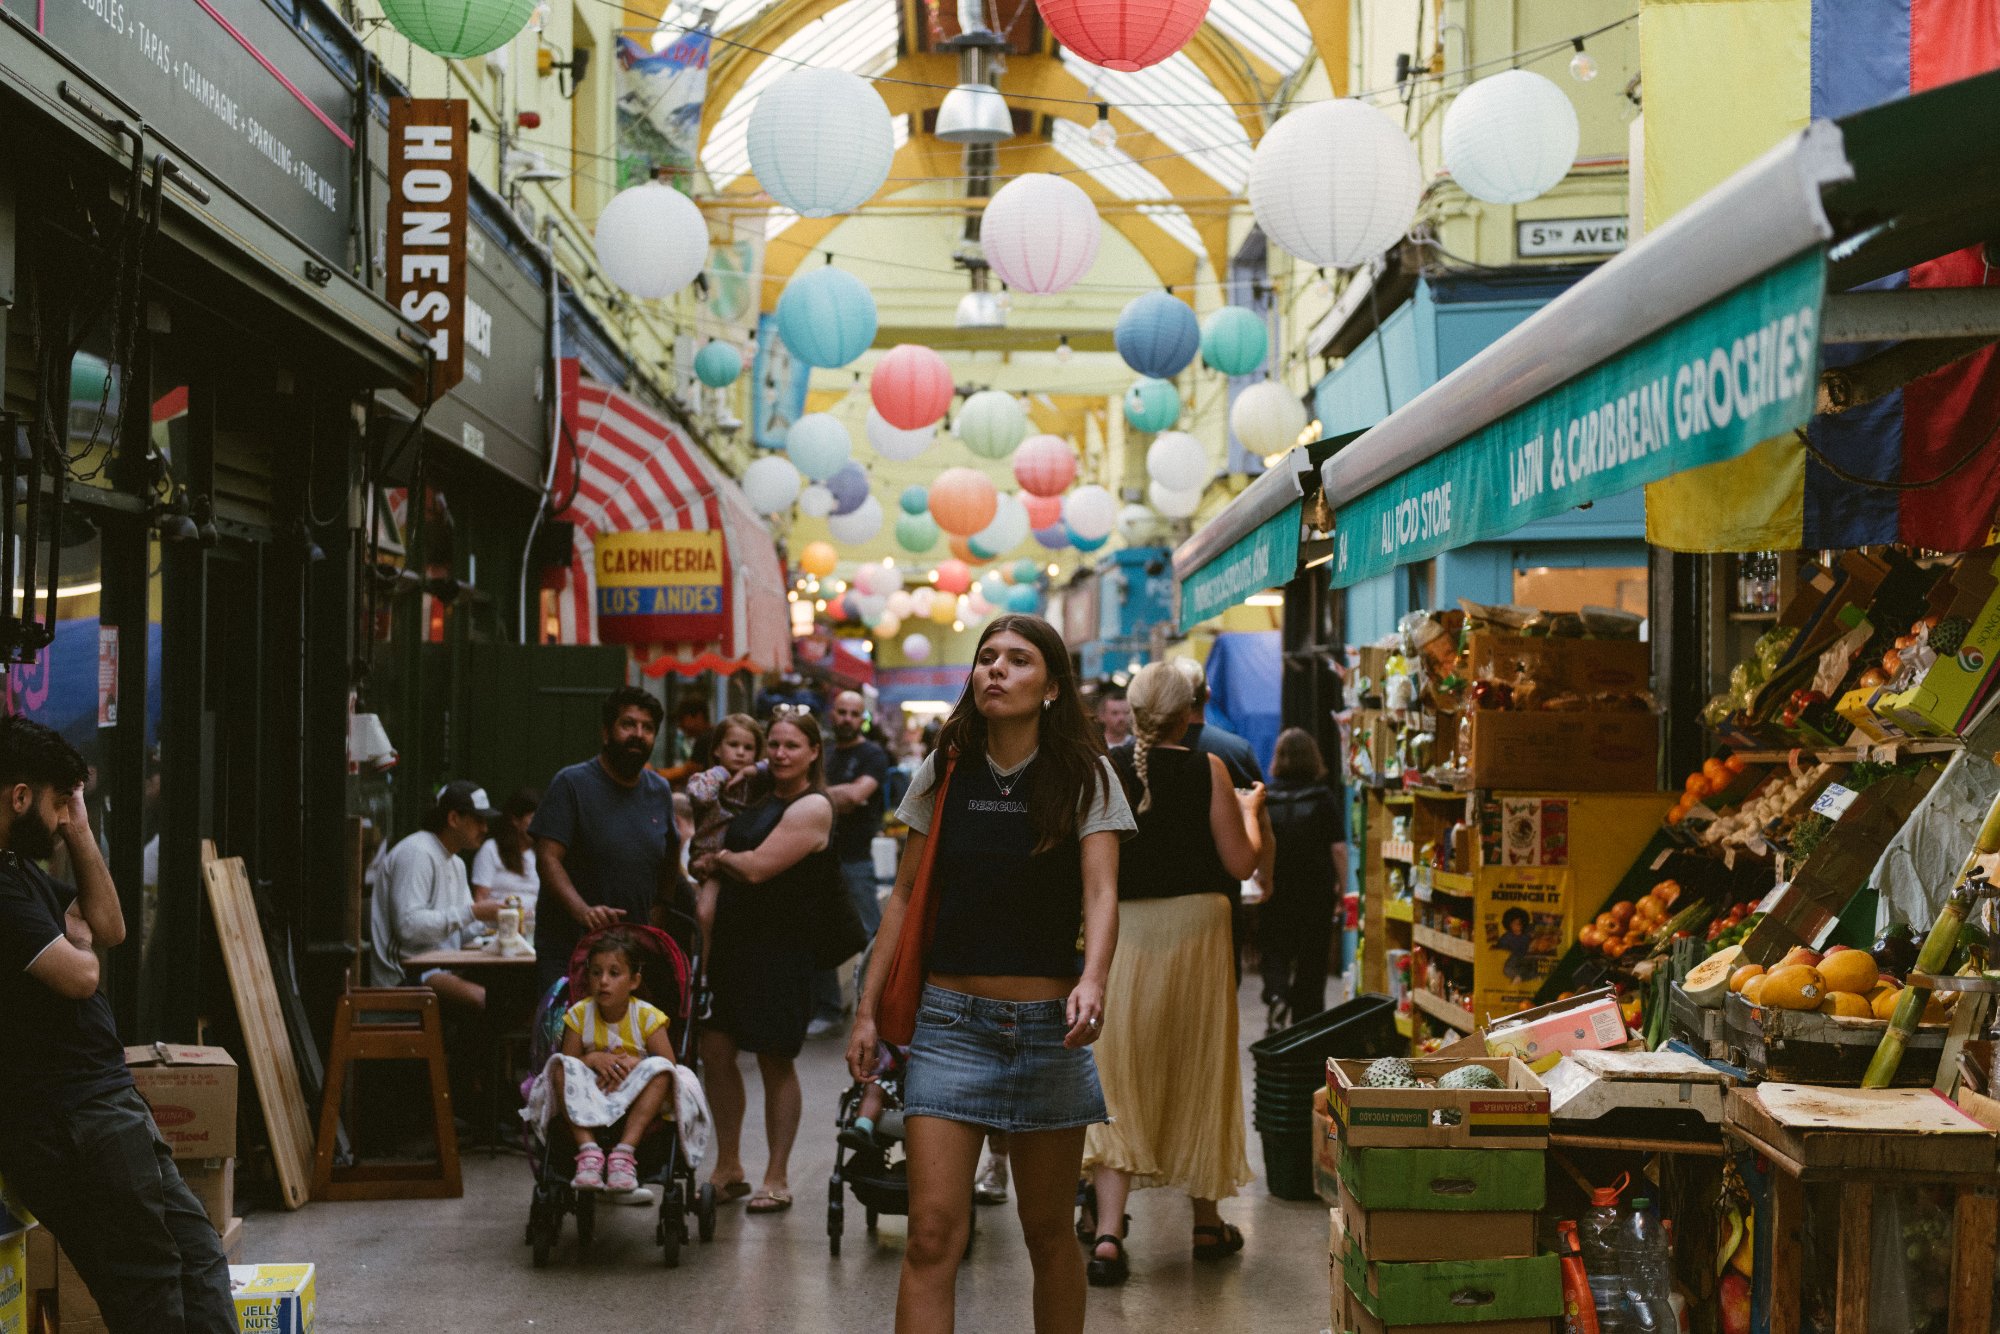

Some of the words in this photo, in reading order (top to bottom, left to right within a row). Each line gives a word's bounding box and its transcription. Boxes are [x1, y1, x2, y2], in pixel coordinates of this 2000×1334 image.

[138, 22, 170, 74] TAPAS
[182, 62, 239, 131] CHAMPAGNE
[248, 116, 292, 176] SPARKLING
[299, 160, 317, 197] FINE
[318, 178, 337, 213] WINE
[401, 125, 453, 360] HONEST
[1509, 434, 1544, 507] LATIN
[1551, 427, 1566, 490] &
[1567, 375, 1670, 483] CARIBBEAN
[602, 547, 717, 573] CARNICERIA
[602, 588, 640, 614] LOS
[653, 586, 718, 612] ANDES
[1359, 1112, 1391, 1122] AVOCADO
[242, 1305, 281, 1317] JELLY
[245, 1317, 279, 1329] NUTS
